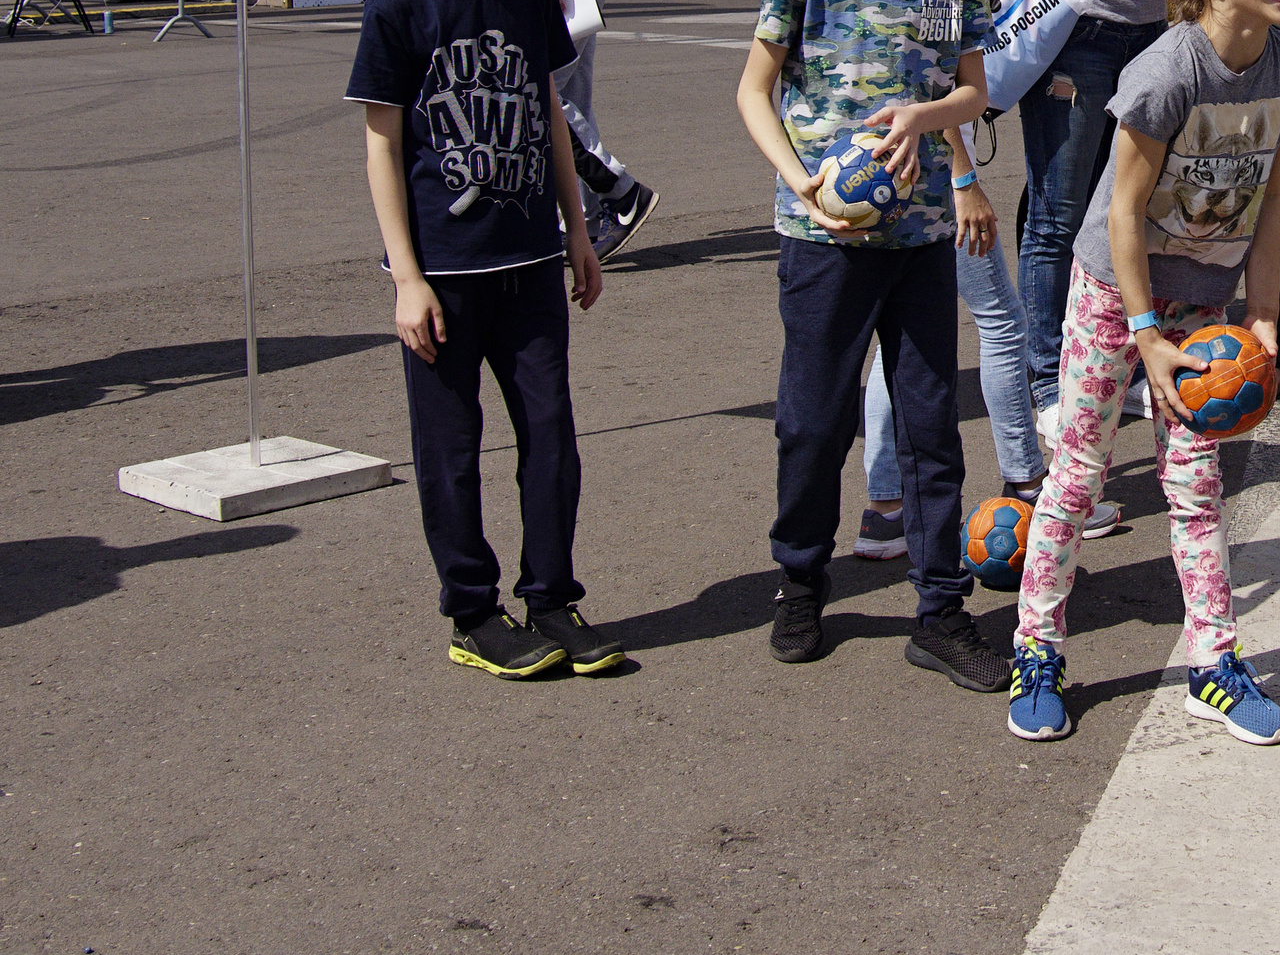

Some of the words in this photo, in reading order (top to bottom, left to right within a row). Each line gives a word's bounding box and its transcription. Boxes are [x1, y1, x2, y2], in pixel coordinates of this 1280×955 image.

[917, 18, 963, 42] BEGIN
[921, 7, 963, 19] ADVENTURE
[432, 30, 524, 93] JUST
[426, 82, 545, 152] AWE
[441, 145, 546, 195] SOME!
